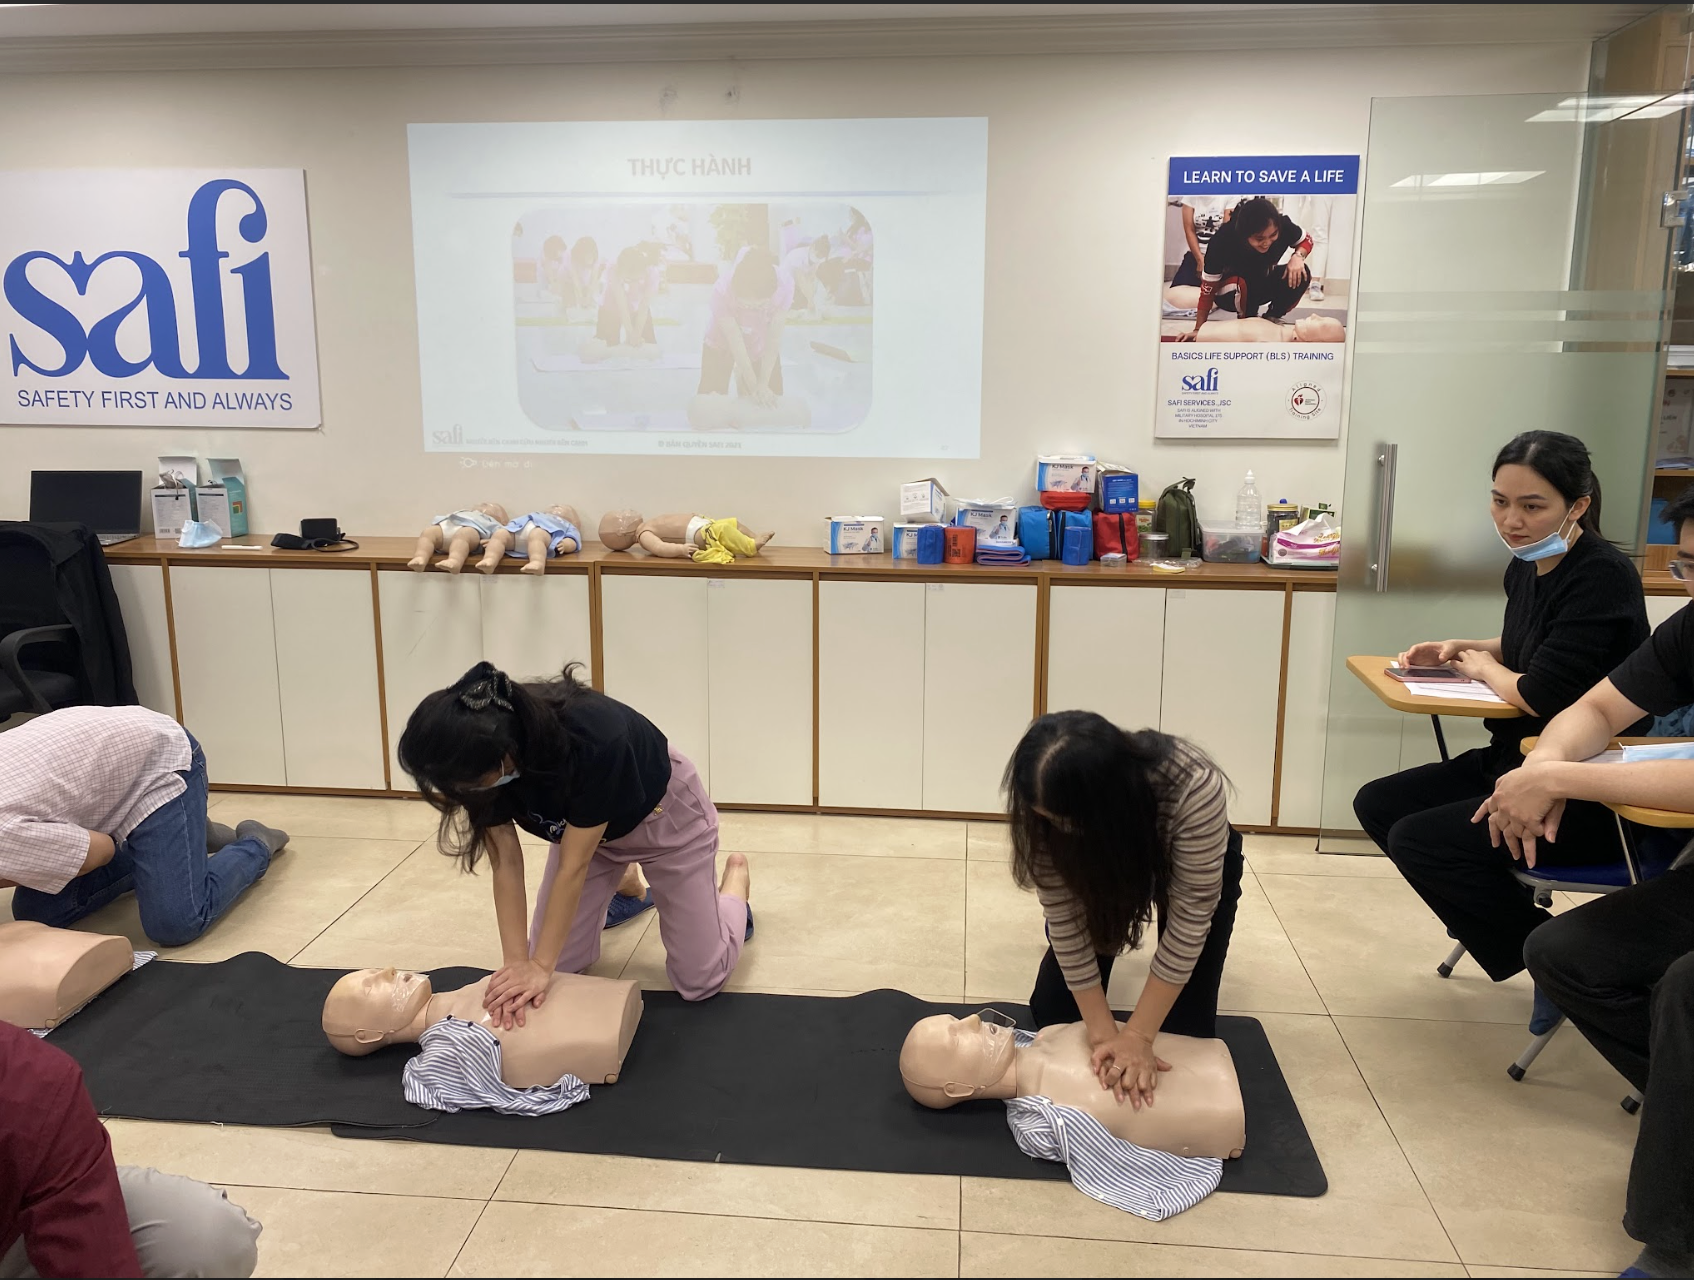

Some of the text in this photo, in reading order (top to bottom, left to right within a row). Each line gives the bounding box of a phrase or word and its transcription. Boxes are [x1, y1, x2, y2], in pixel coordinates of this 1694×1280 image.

[626, 152, 752, 181] THỰC HÀNH
[1183, 169, 1344, 184] LEARN TO SAVE A LIFE
[3, 178, 290, 381] safi
[1171, 352, 1203, 361] BASICS
[1204, 352, 1222, 360] LIFE
[1223, 352, 1264, 361] SUPPORT
[1292, 352, 1334, 361] TRAINING
[1181, 367, 1219, 391] safi
[17, 389, 293, 411] SAFETY FIRST AND ALWAYS
